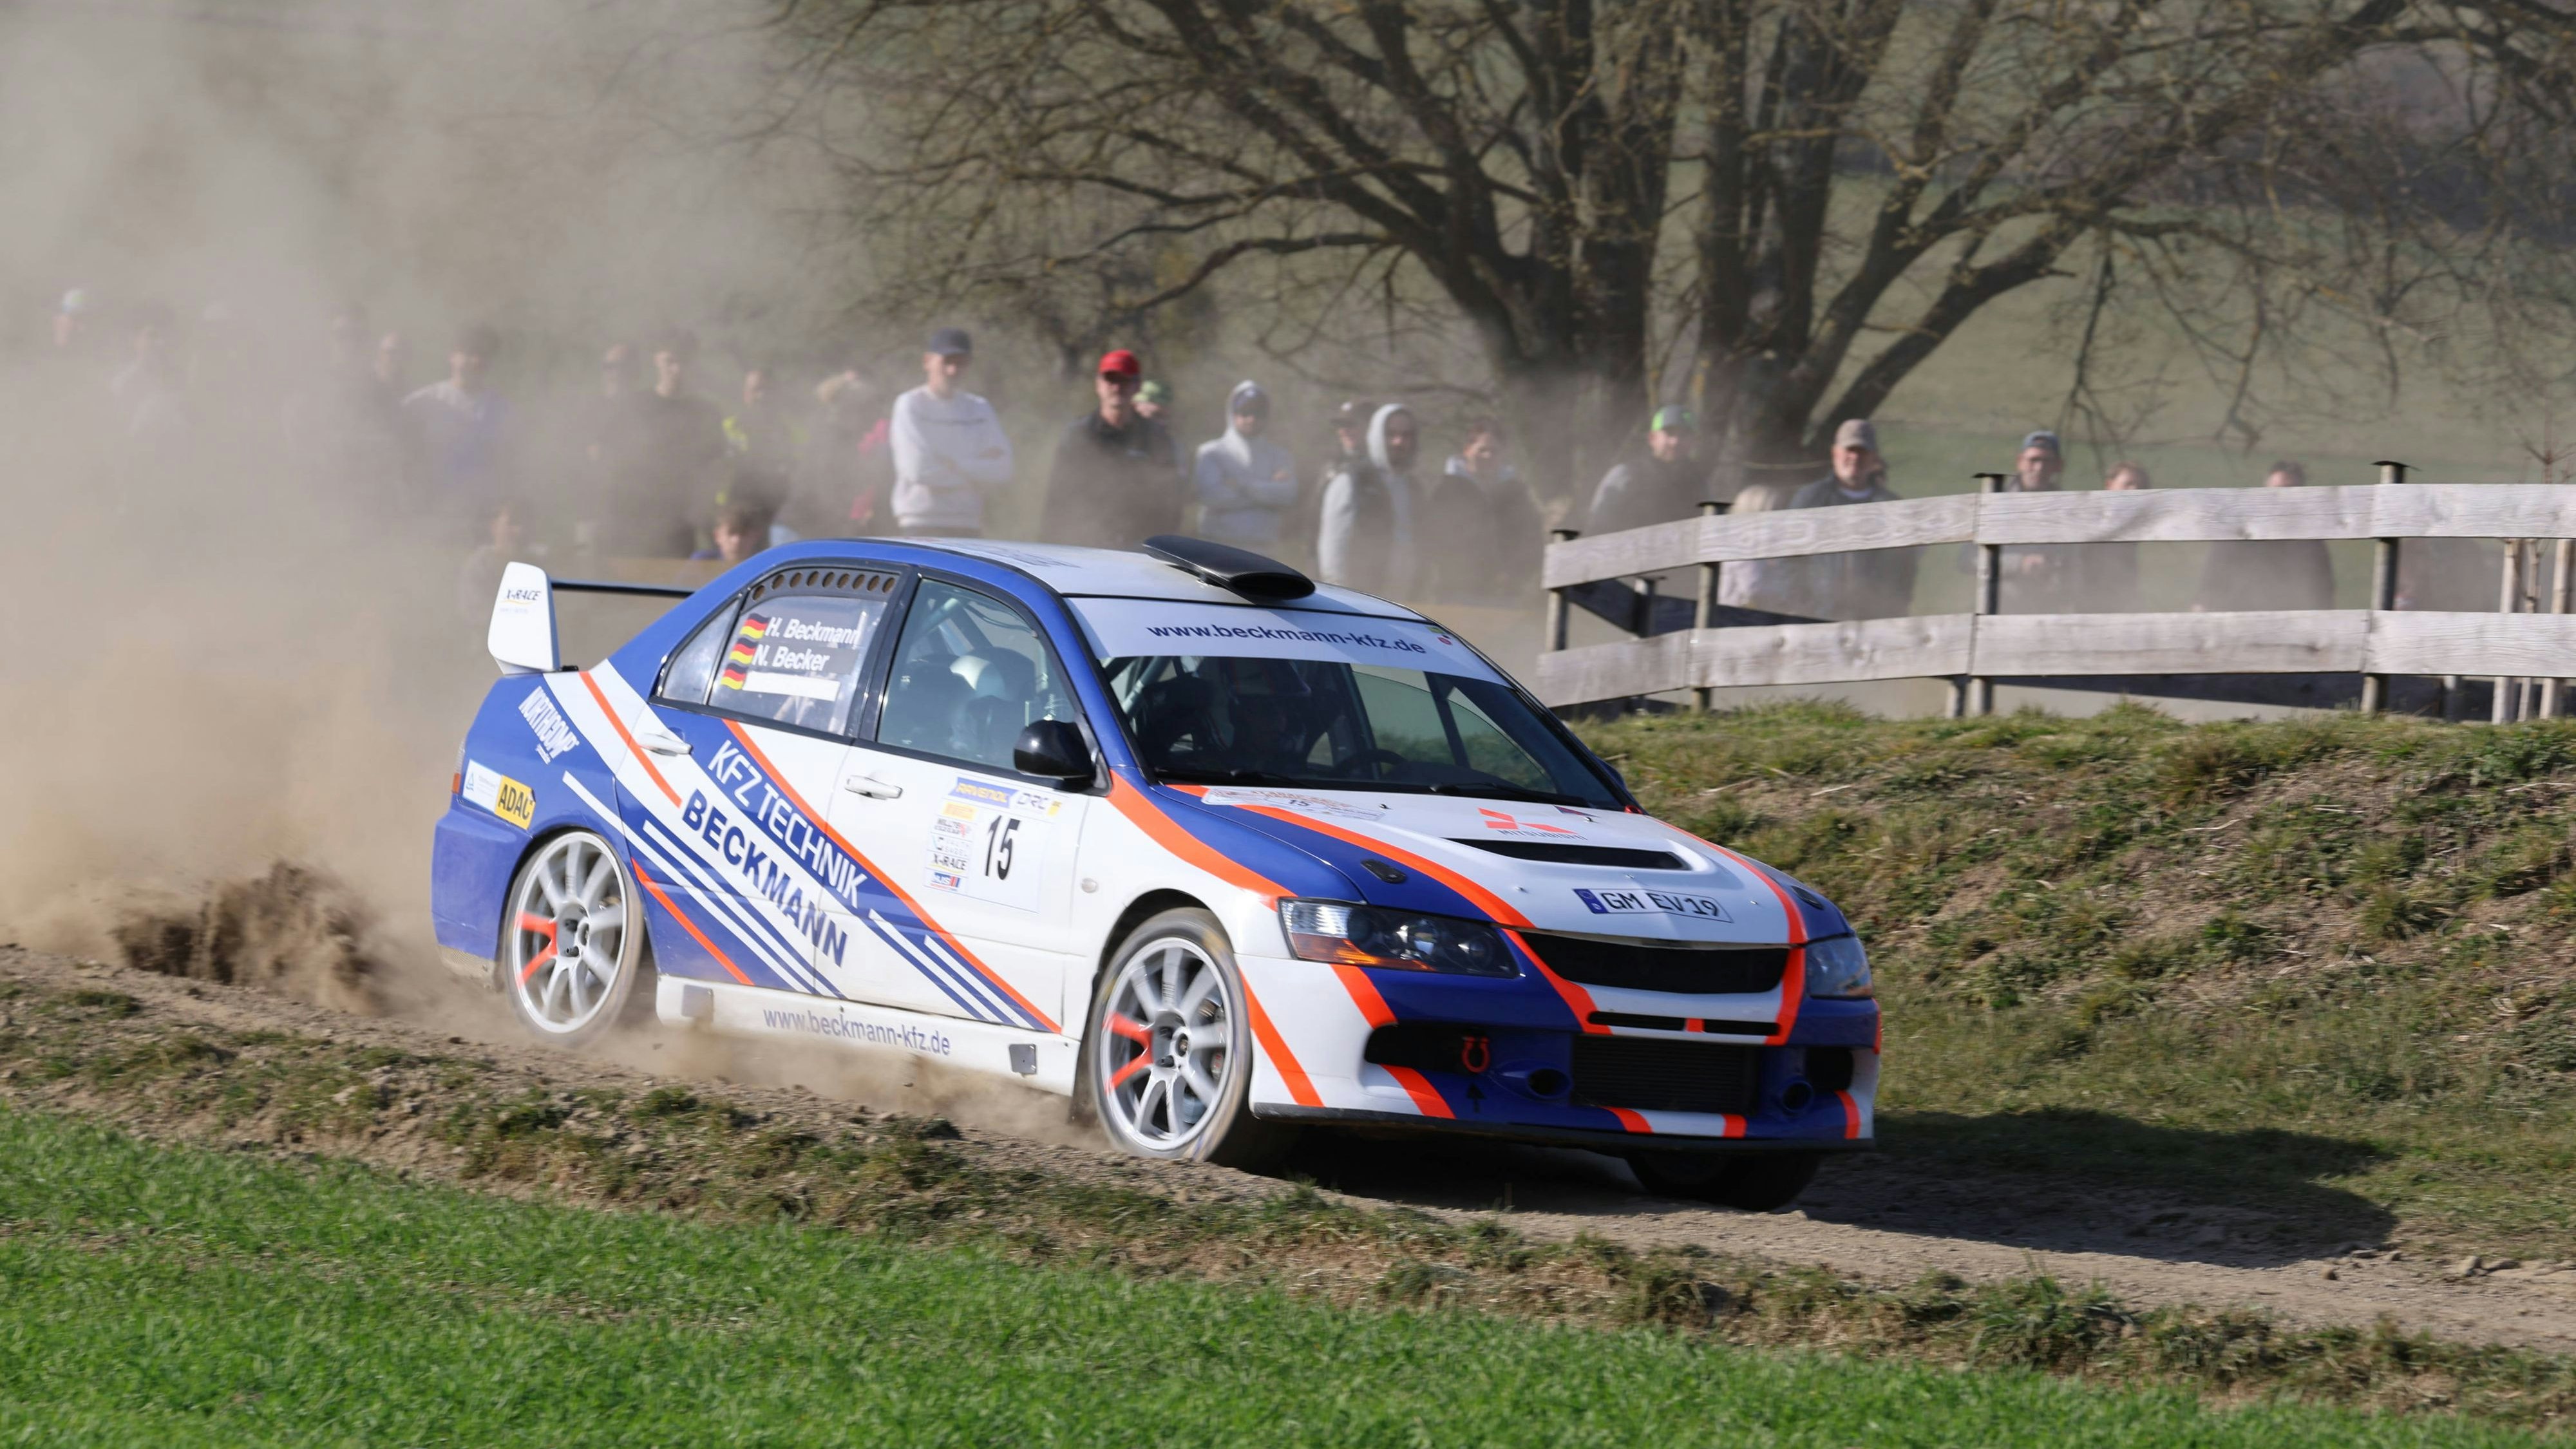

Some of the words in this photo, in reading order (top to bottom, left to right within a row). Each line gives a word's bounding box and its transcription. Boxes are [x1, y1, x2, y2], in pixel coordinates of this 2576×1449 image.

[764, 616, 782, 638] H.
[784, 618, 860, 645] Beckmann
[1147, 624, 1426, 654] www.beckmann-kfz.de
[752, 644, 768, 666] N.
[772, 646, 831, 671] Becker
[497, 784, 533, 820] ADAC
[708, 740, 762, 808] KFZ
[756, 785, 868, 908] TECHNIK
[932, 853, 967, 871] X-RACE
[985, 814, 1021, 880] 15
[681, 788, 848, 968] BECKMANN
[1600, 893, 1647, 910] GM
[1645, 893, 1719, 916] EV19
[763, 1009, 951, 1056] www.beckmann-kfz.de
